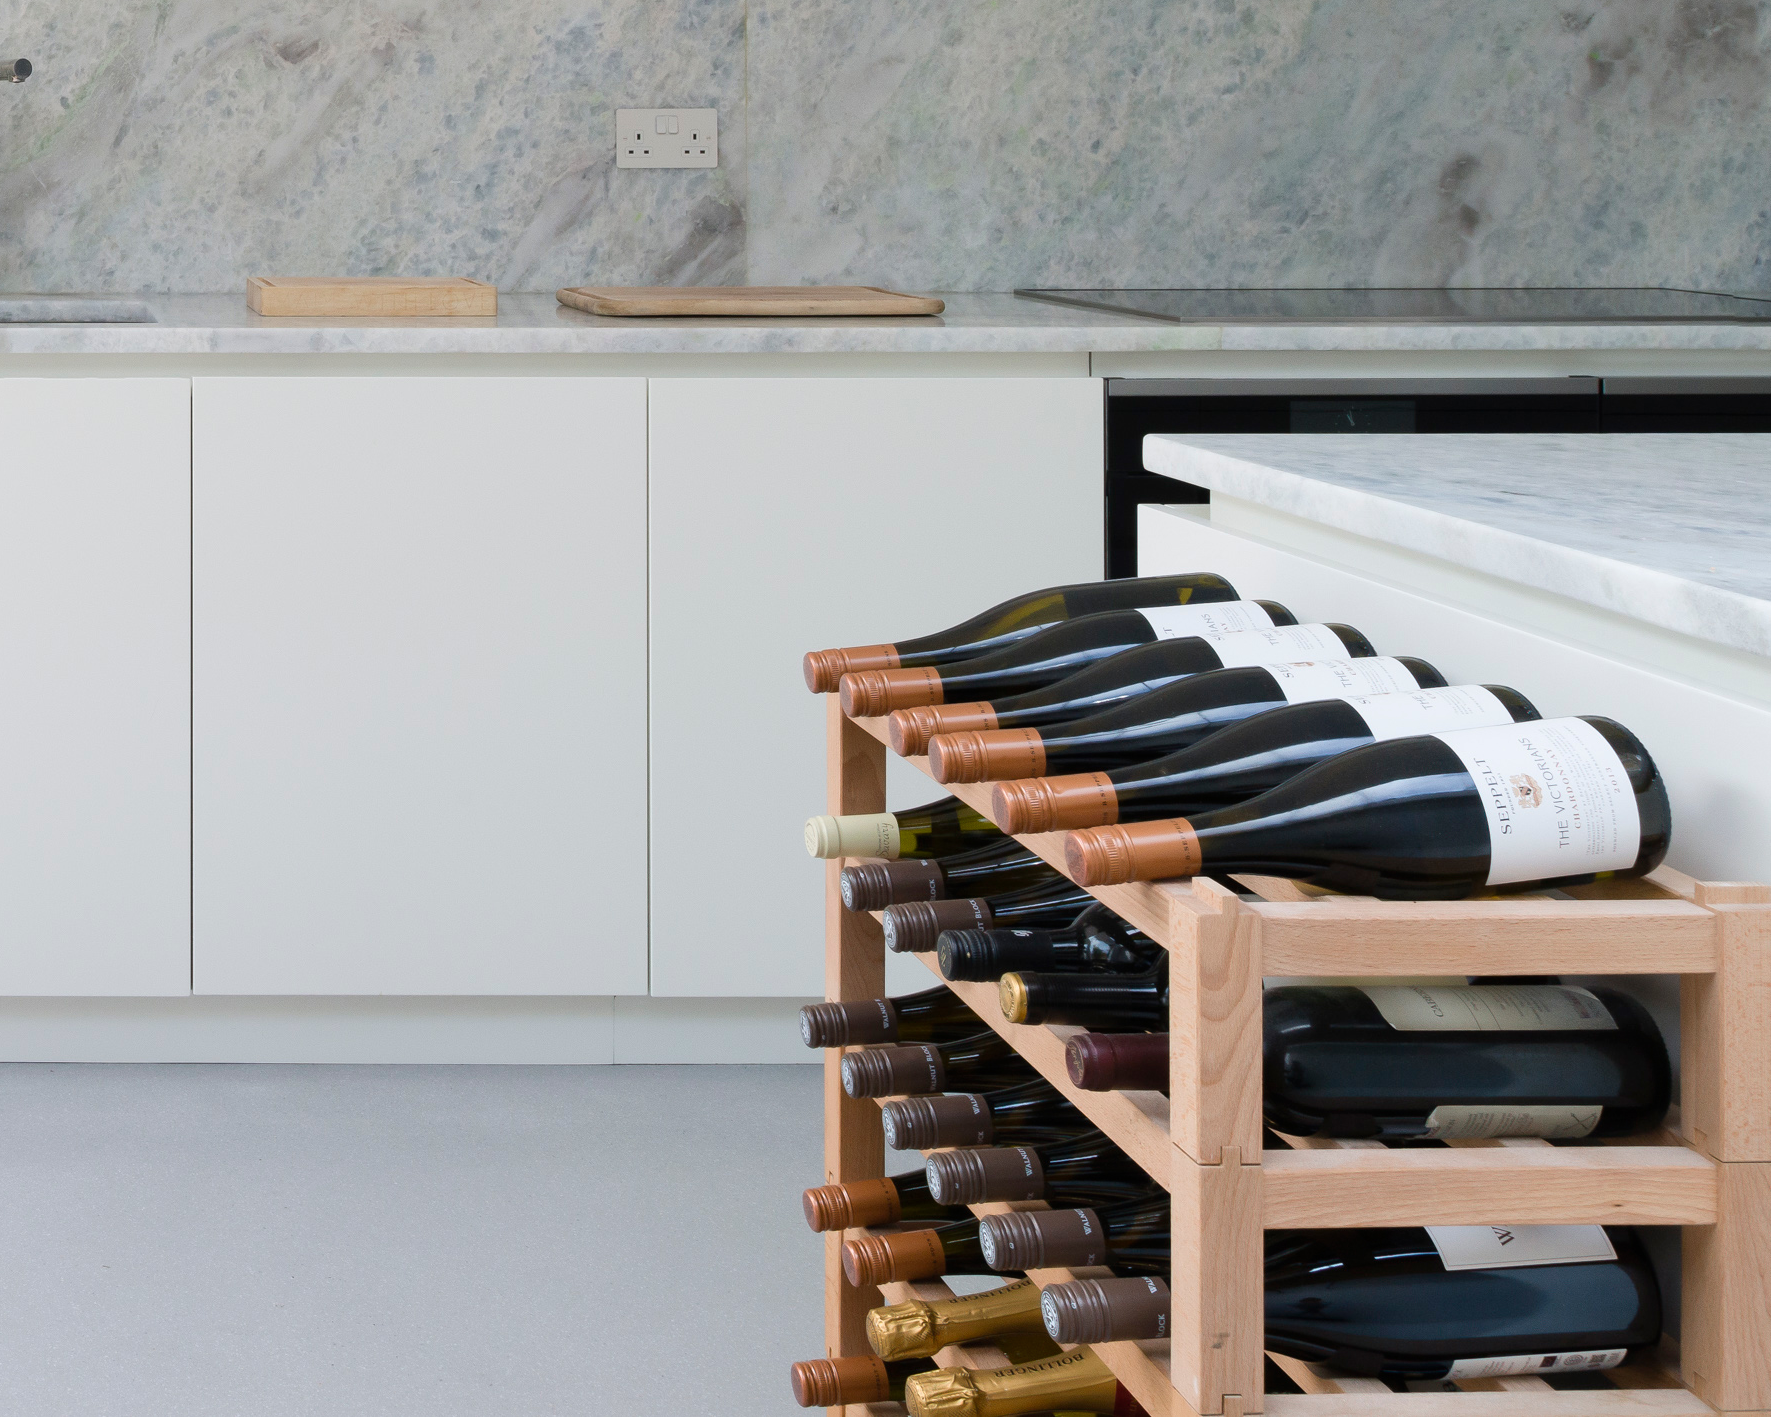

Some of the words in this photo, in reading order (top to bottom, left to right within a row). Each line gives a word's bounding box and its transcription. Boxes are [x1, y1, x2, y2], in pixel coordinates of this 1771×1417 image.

[1334, 671, 1352, 688] THE
[1412, 695, 1433, 711] THE
[1518, 737, 1566, 814] VICTORIANS
[1605, 767, 1620, 793] 2013
[1474, 757, 1512, 835] SEPPELT
[1546, 749, 1581, 829] CHARDONNAY
[1558, 821, 1570, 849] THE
[877, 1002, 890, 1029] WALNUT
[949, 1279, 1031, 1304] BOLLINGER
[994, 1353, 1085, 1377] BOLLINGER
